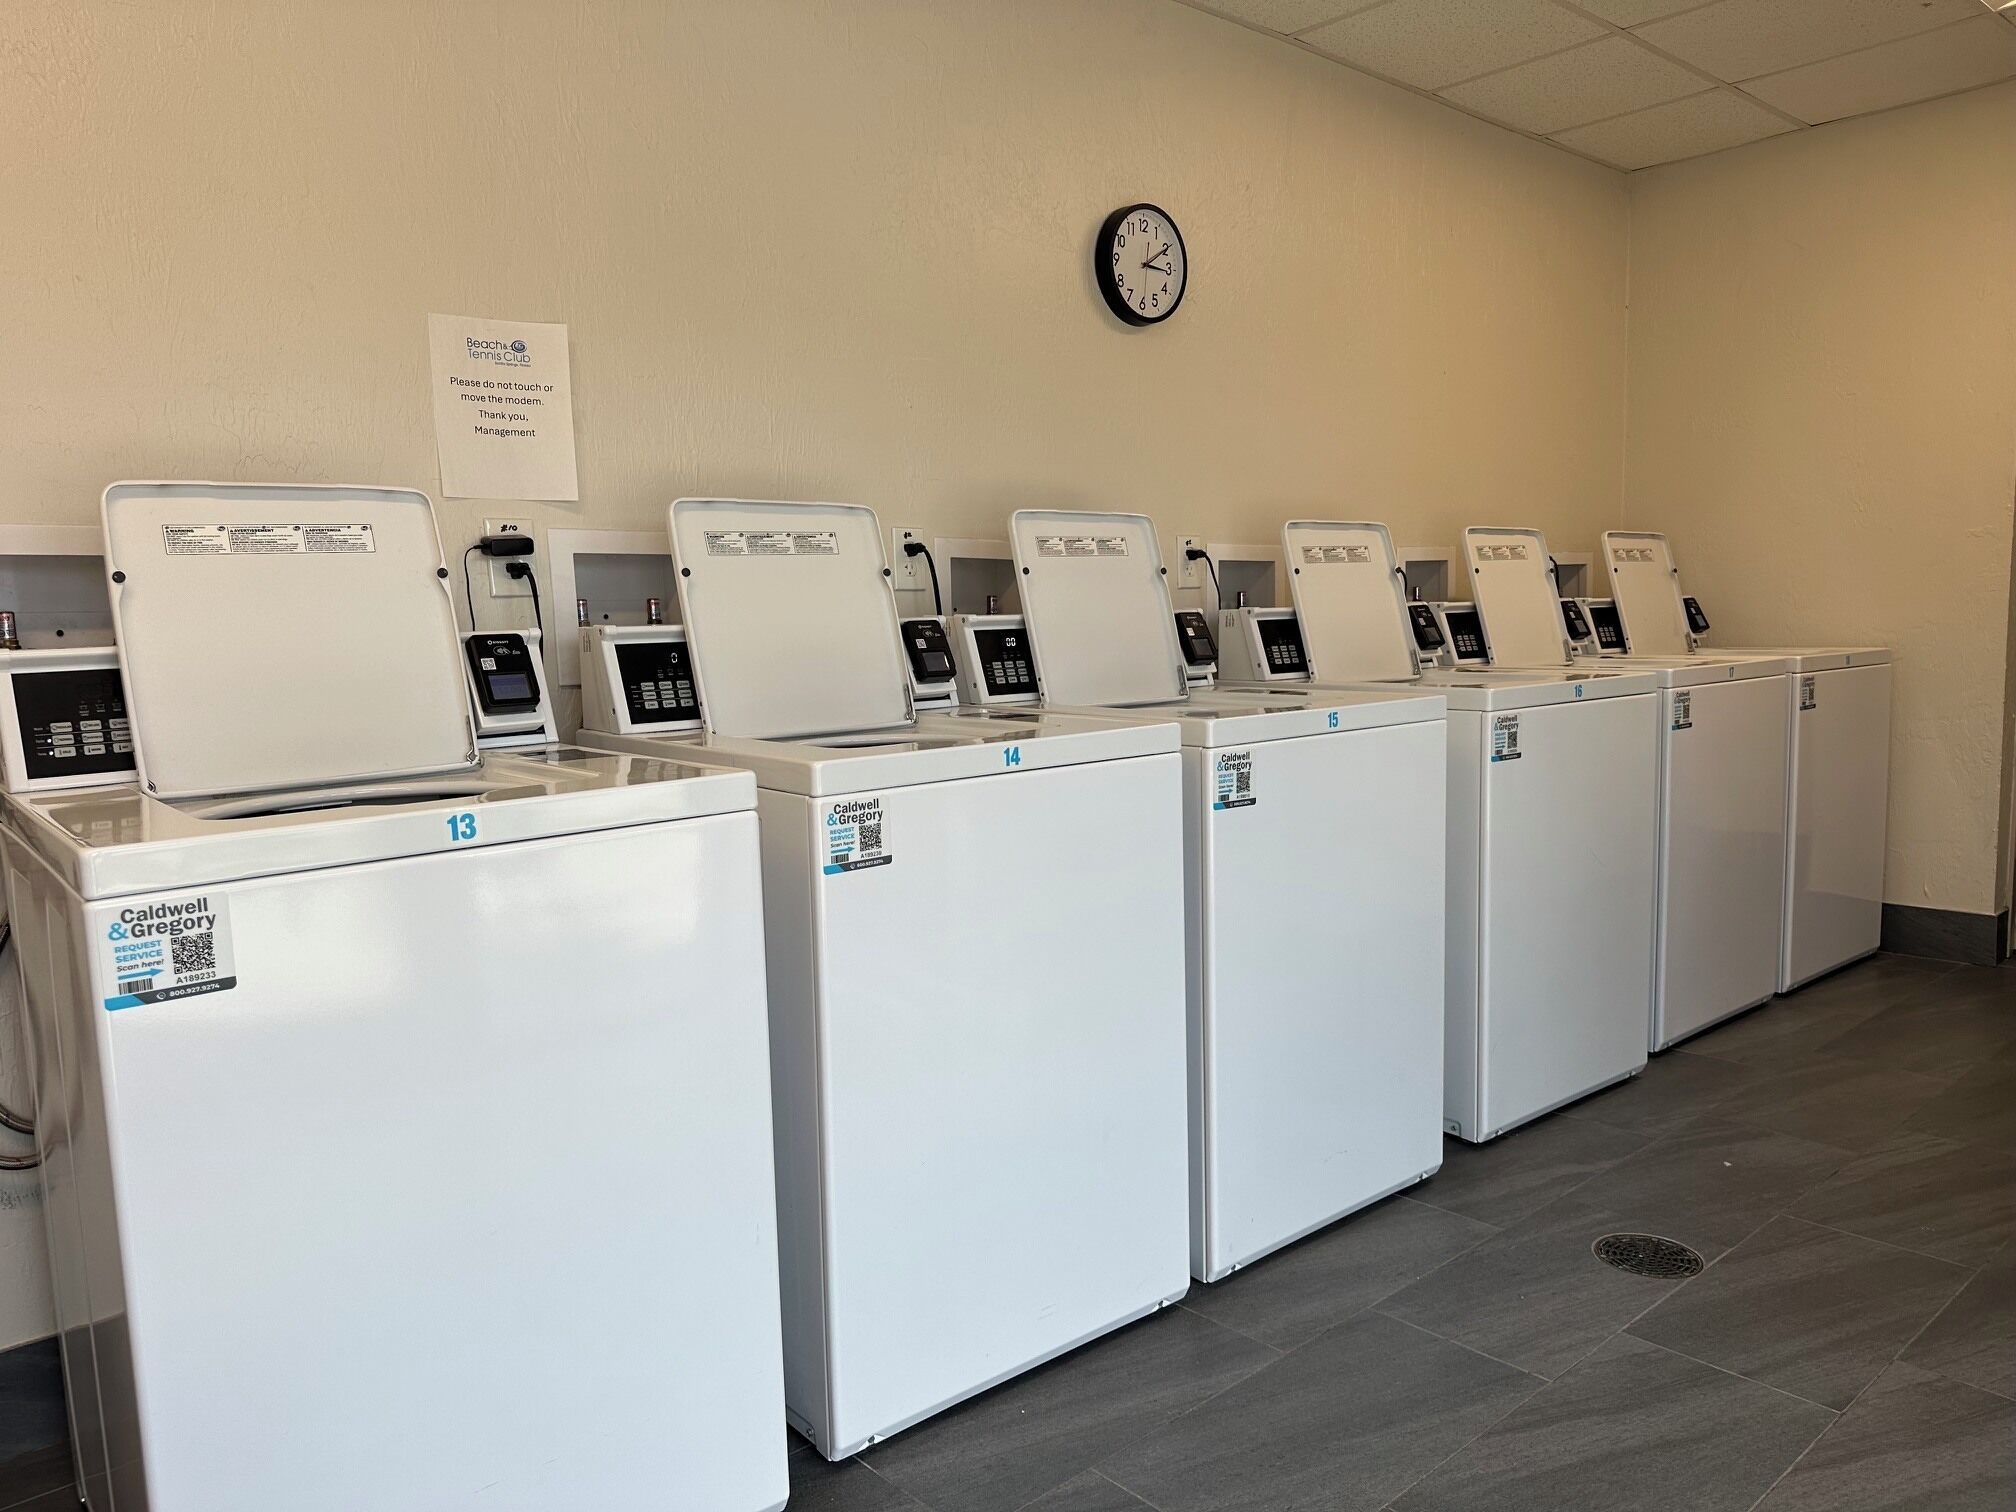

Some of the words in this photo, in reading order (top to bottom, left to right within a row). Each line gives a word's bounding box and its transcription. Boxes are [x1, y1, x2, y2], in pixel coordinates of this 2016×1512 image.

[1127, 222, 1135, 236] 11
[1139, 218, 1148, 233] 12
[1116, 233, 1125, 248] 10
[1154, 227, 1158, 240] 1
[1162, 243, 1169, 256] 2
[1113, 252, 1120, 266] 9
[1166, 262, 1171, 275] 3
[1117, 274, 1124, 287] 8
[1127, 288, 1134, 302] 7
[1161, 282, 1167, 295] 4
[1139, 296, 1146, 310] 6
[1152, 294, 1158, 307] 5
[468, 348, 502, 361] Tennis
[503, 351, 531, 363] Club
[450, 377, 481, 388] Please
[483, 380, 495, 389] do
[497, 381, 512, 390] not
[514, 382, 542, 392] touch
[544, 384, 553, 392] or
[461, 393, 486, 403] move
[488, 394, 503, 404] the
[505, 396, 544, 406] modem.
[478, 410, 507, 420] Thank
[508, 413, 529, 422] you,
[474, 426, 536, 437] Management
[501, 524, 518, 532] #10
[1575, 684, 1582, 698] 16
[1328, 711, 1338, 728] 15
[1004, 746, 1021, 766] 14
[1221, 751, 1250, 763] Caldwell
[833, 798, 879, 815] Caldwell
[447, 813, 476, 841] 13
[120, 897, 208, 924] Caldwell
[114, 939, 162, 953] REQUEST
[115, 949, 163, 963] SERVICE
[117, 964, 139, 972] Scan
[142, 958, 164, 968] here!
[176, 971, 216, 984] A189233
[169, 983, 220, 997] 800.927.9274
